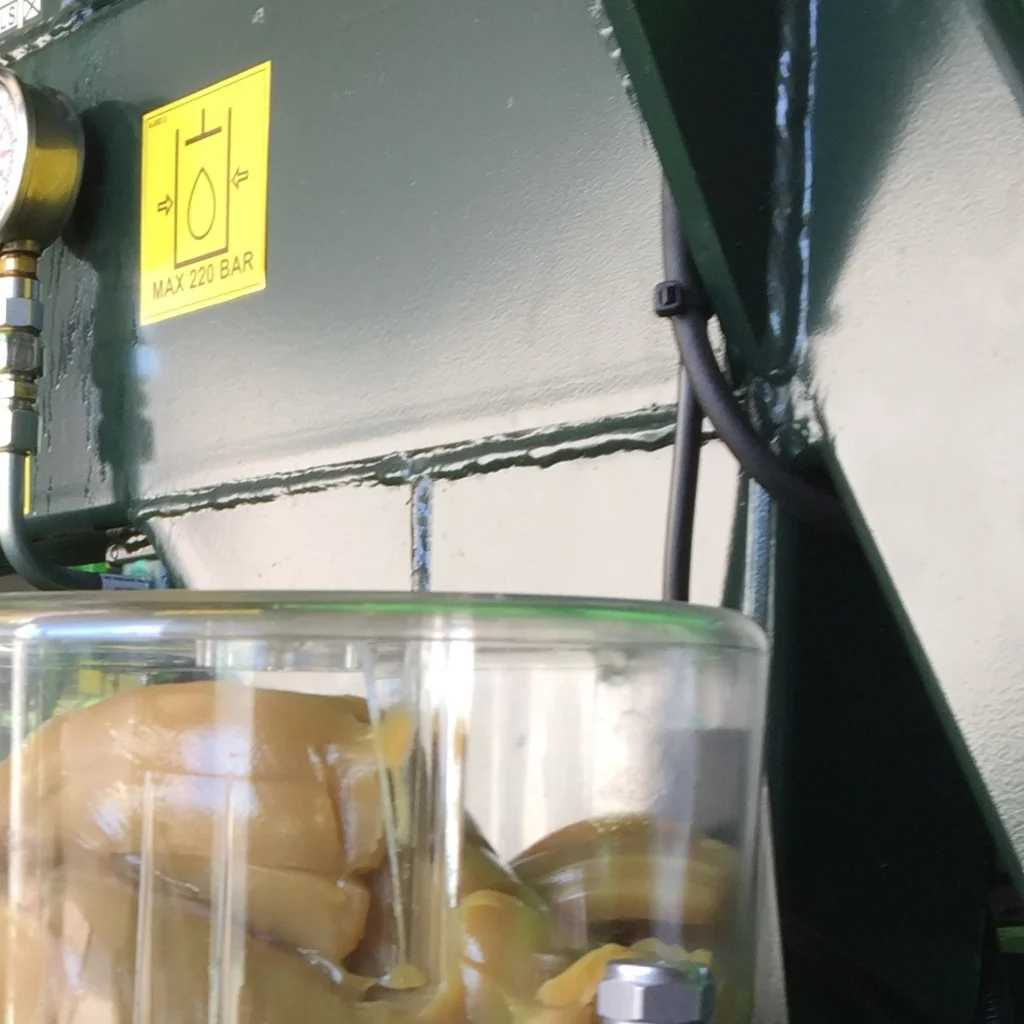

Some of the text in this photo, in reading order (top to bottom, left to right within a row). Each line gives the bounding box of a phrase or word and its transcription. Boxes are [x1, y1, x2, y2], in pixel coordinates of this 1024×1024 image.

[152, 250, 254, 300] MAX 220 BAR
